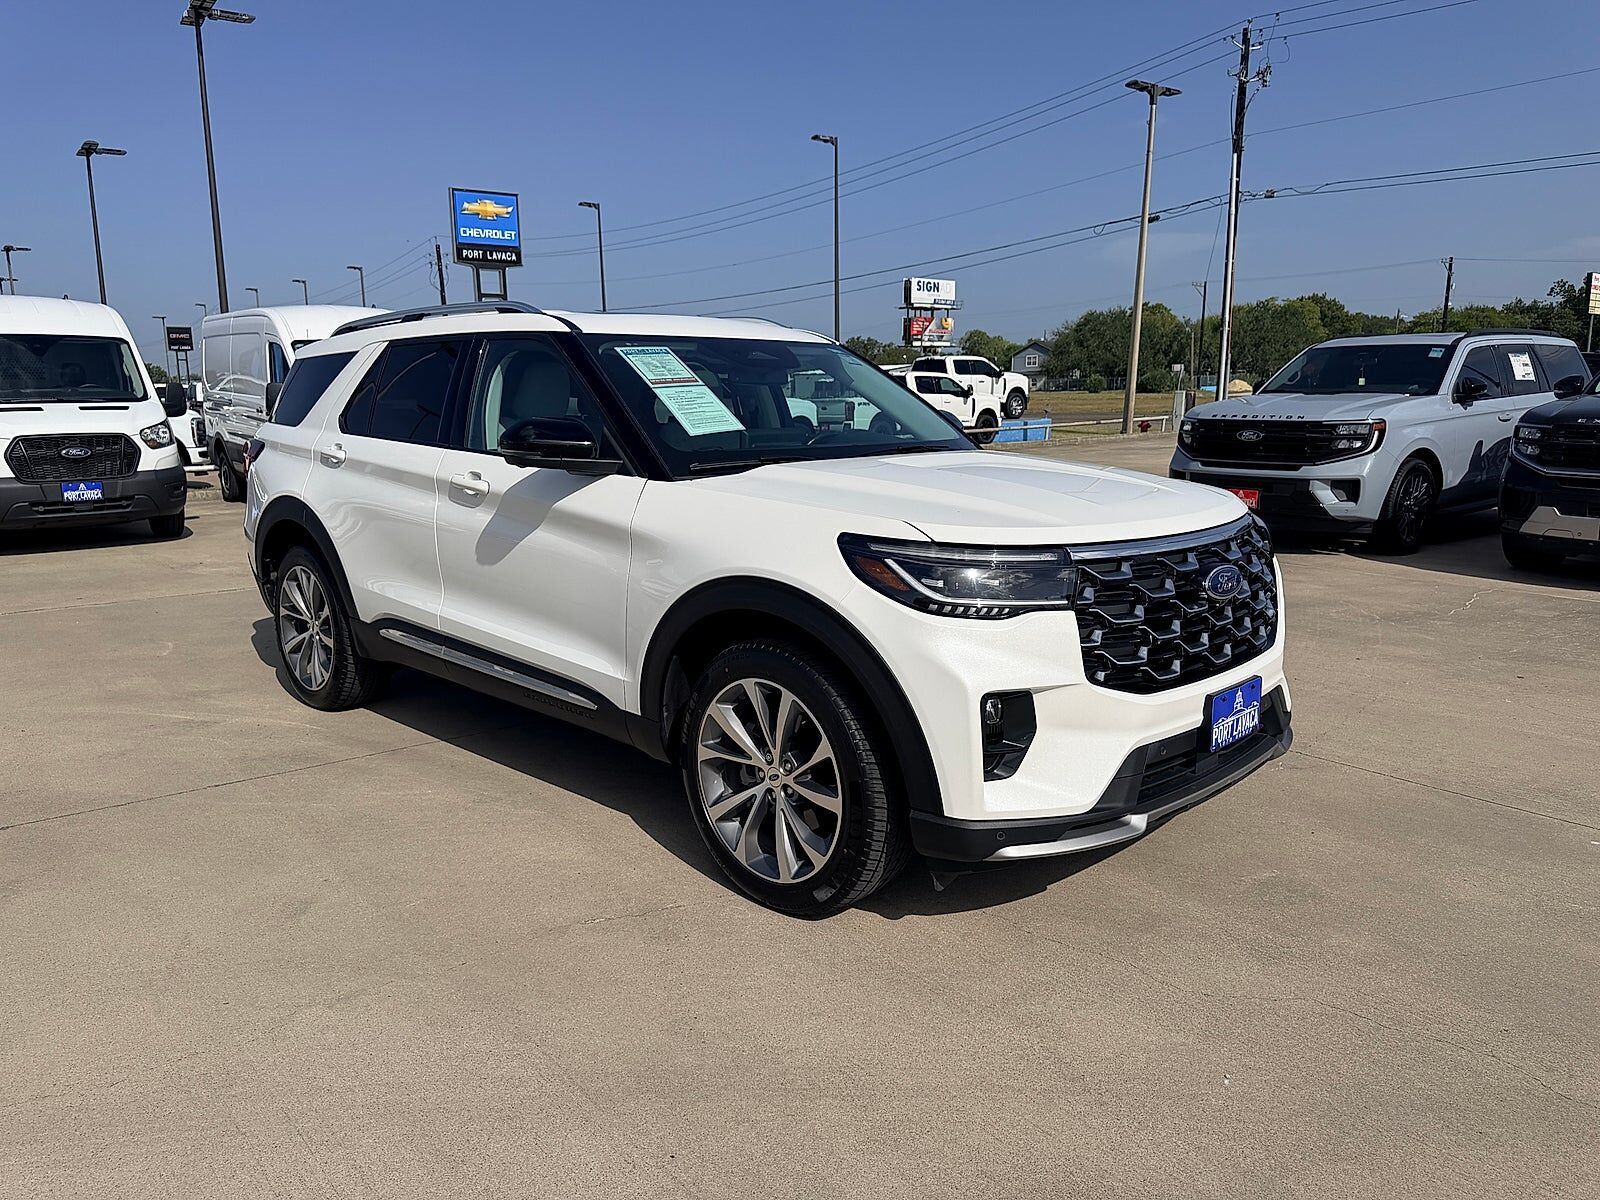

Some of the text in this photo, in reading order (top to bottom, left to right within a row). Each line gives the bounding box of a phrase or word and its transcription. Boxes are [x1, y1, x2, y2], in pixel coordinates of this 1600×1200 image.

[460, 227, 517, 241] CHEVROLET
[462, 249, 517, 261] PORT LAVACA
[1241, 431, 1257, 440] Ford
[63, 489, 103, 502] PORT LAVACA
[1217, 572, 1238, 592] Ford
[1212, 708, 1259, 747] PORT LAVACA
